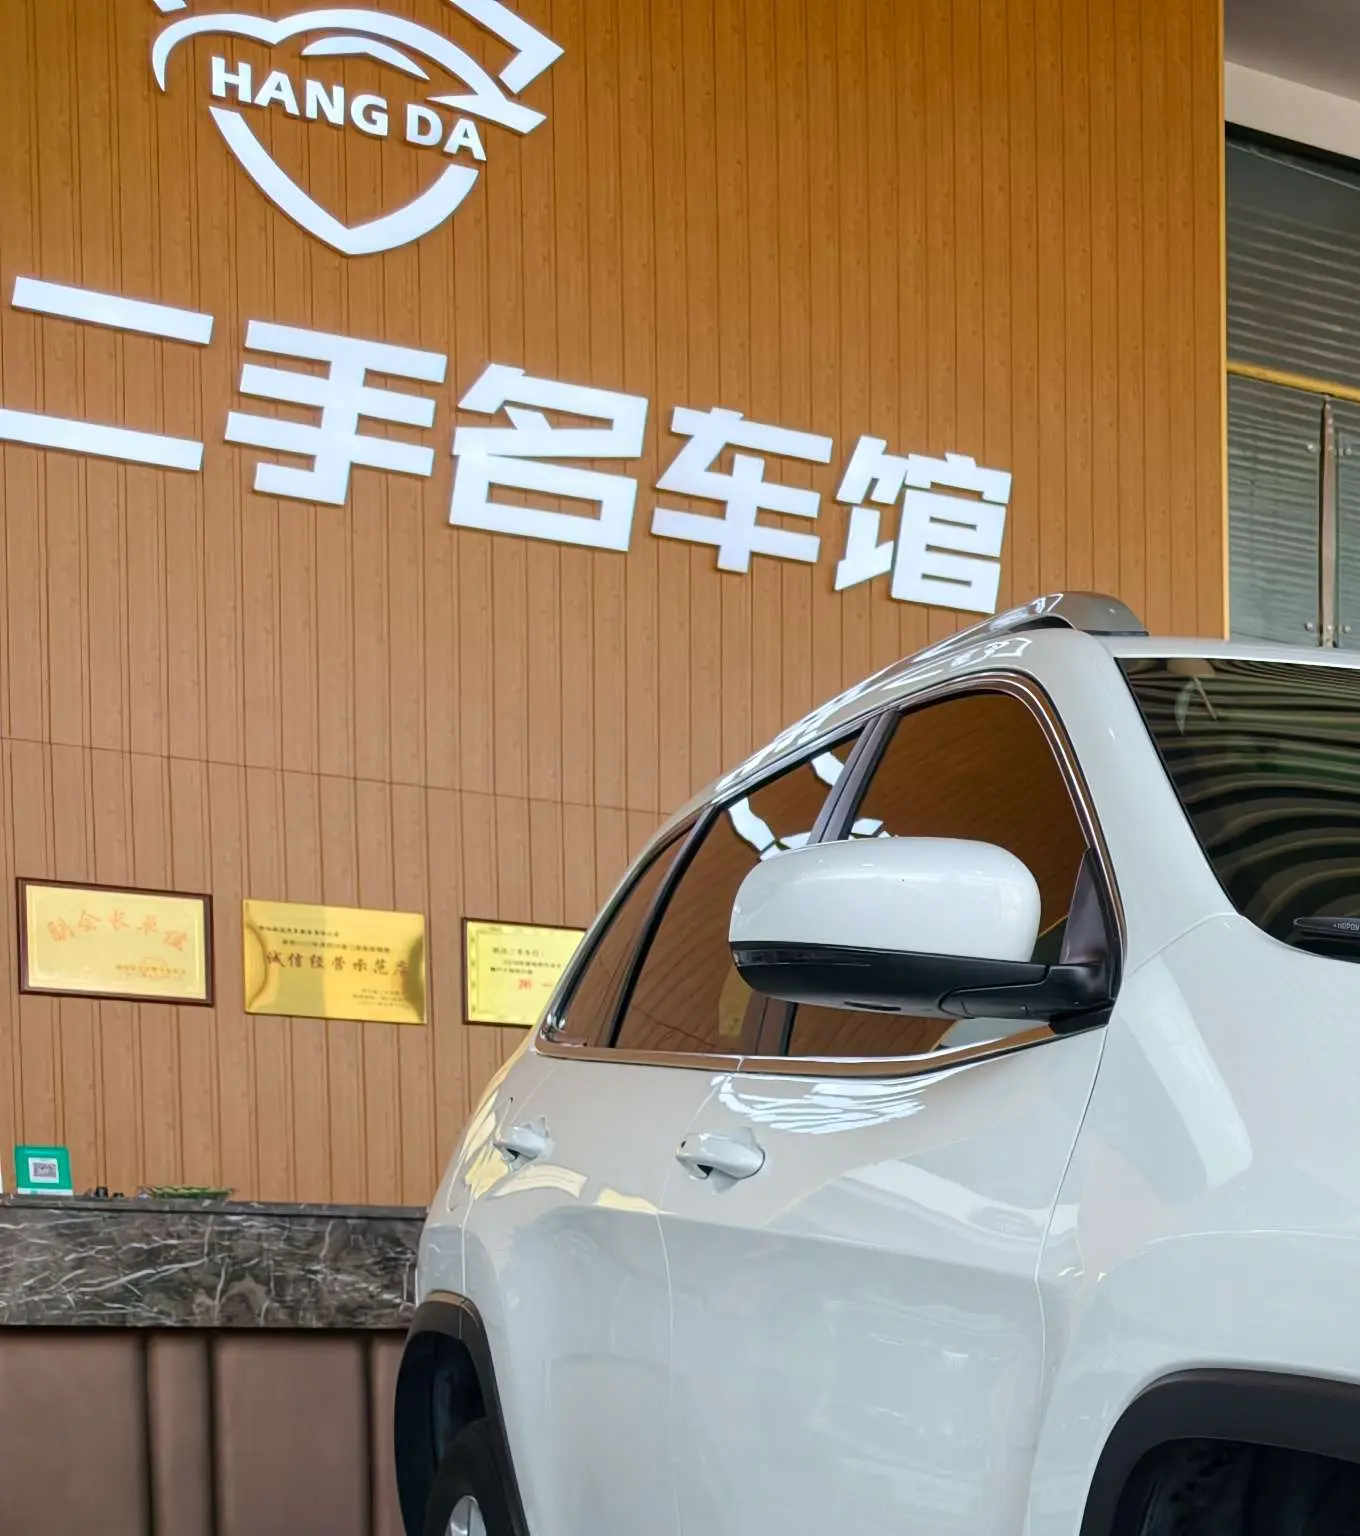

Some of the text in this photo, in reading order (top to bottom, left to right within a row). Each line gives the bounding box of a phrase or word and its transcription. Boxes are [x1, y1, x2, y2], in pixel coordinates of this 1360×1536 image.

[211, 56, 488, 162] HANG DA
[0, 276, 1013, 616] 二手名车馆
